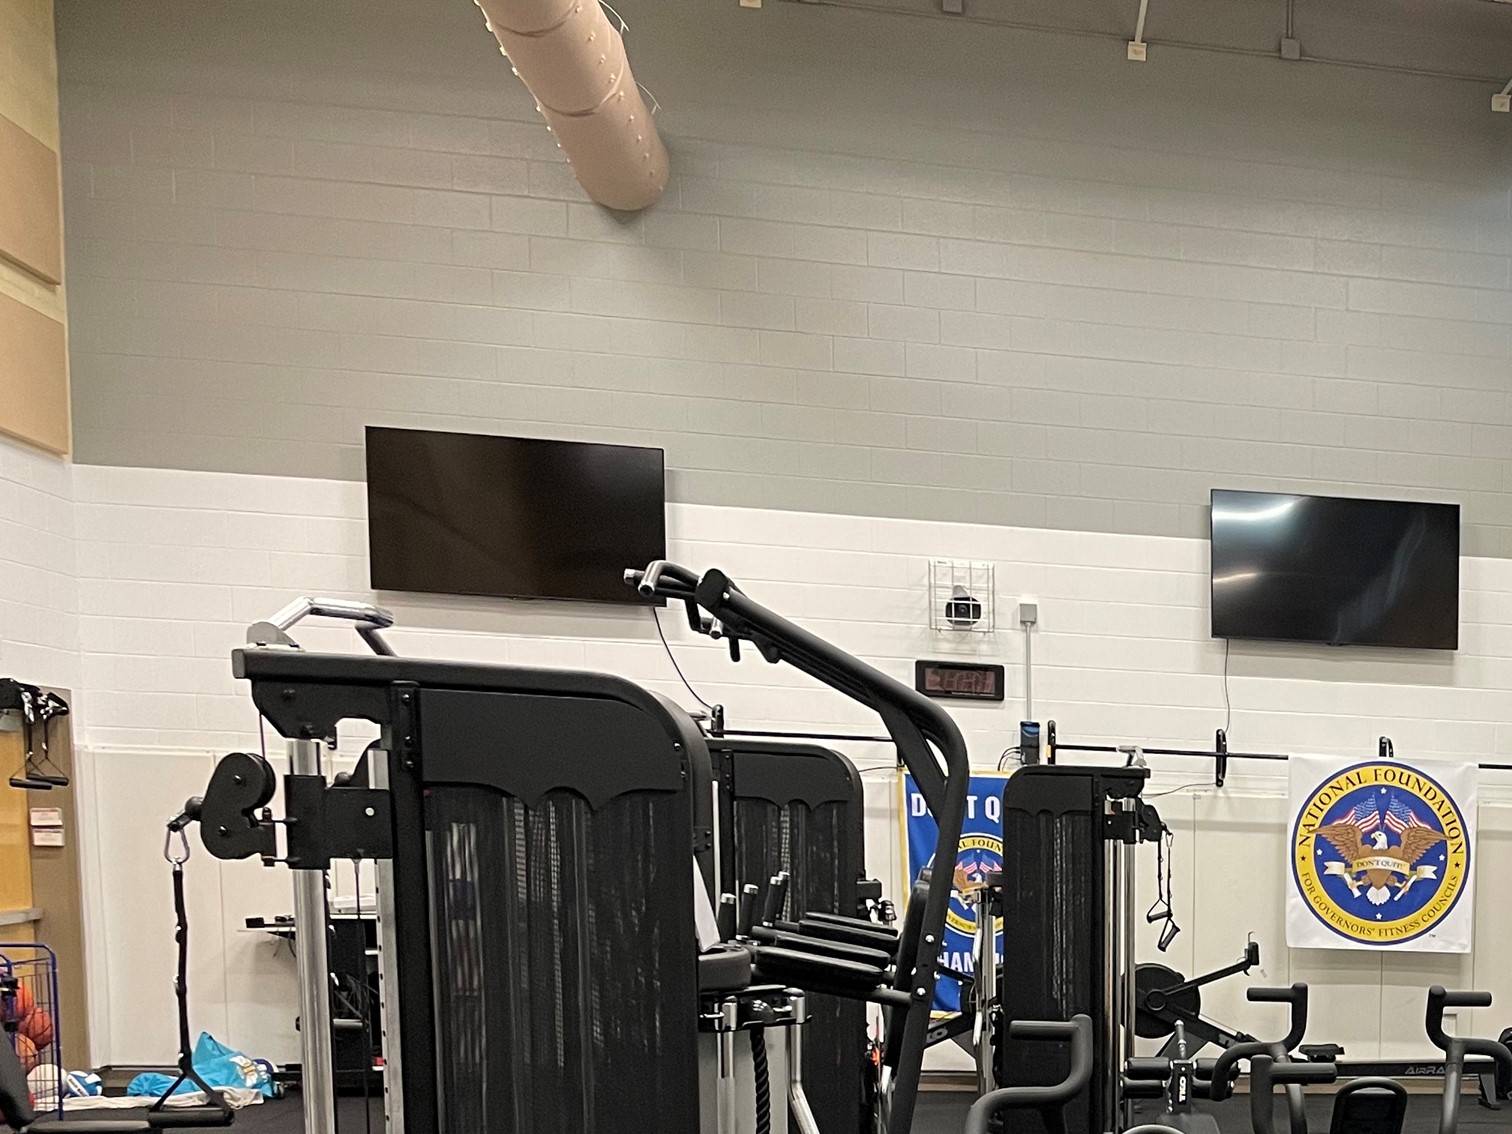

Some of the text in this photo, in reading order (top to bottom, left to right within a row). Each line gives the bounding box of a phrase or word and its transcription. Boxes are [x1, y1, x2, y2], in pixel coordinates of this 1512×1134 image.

[1299, 768, 1464, 855] NATIONAL FOUNDATION
[1301, 872, 1316, 895] FOR
[1378, 919, 1421, 937] FITNESS
[1421, 875, 1458, 923] COUNCILS
